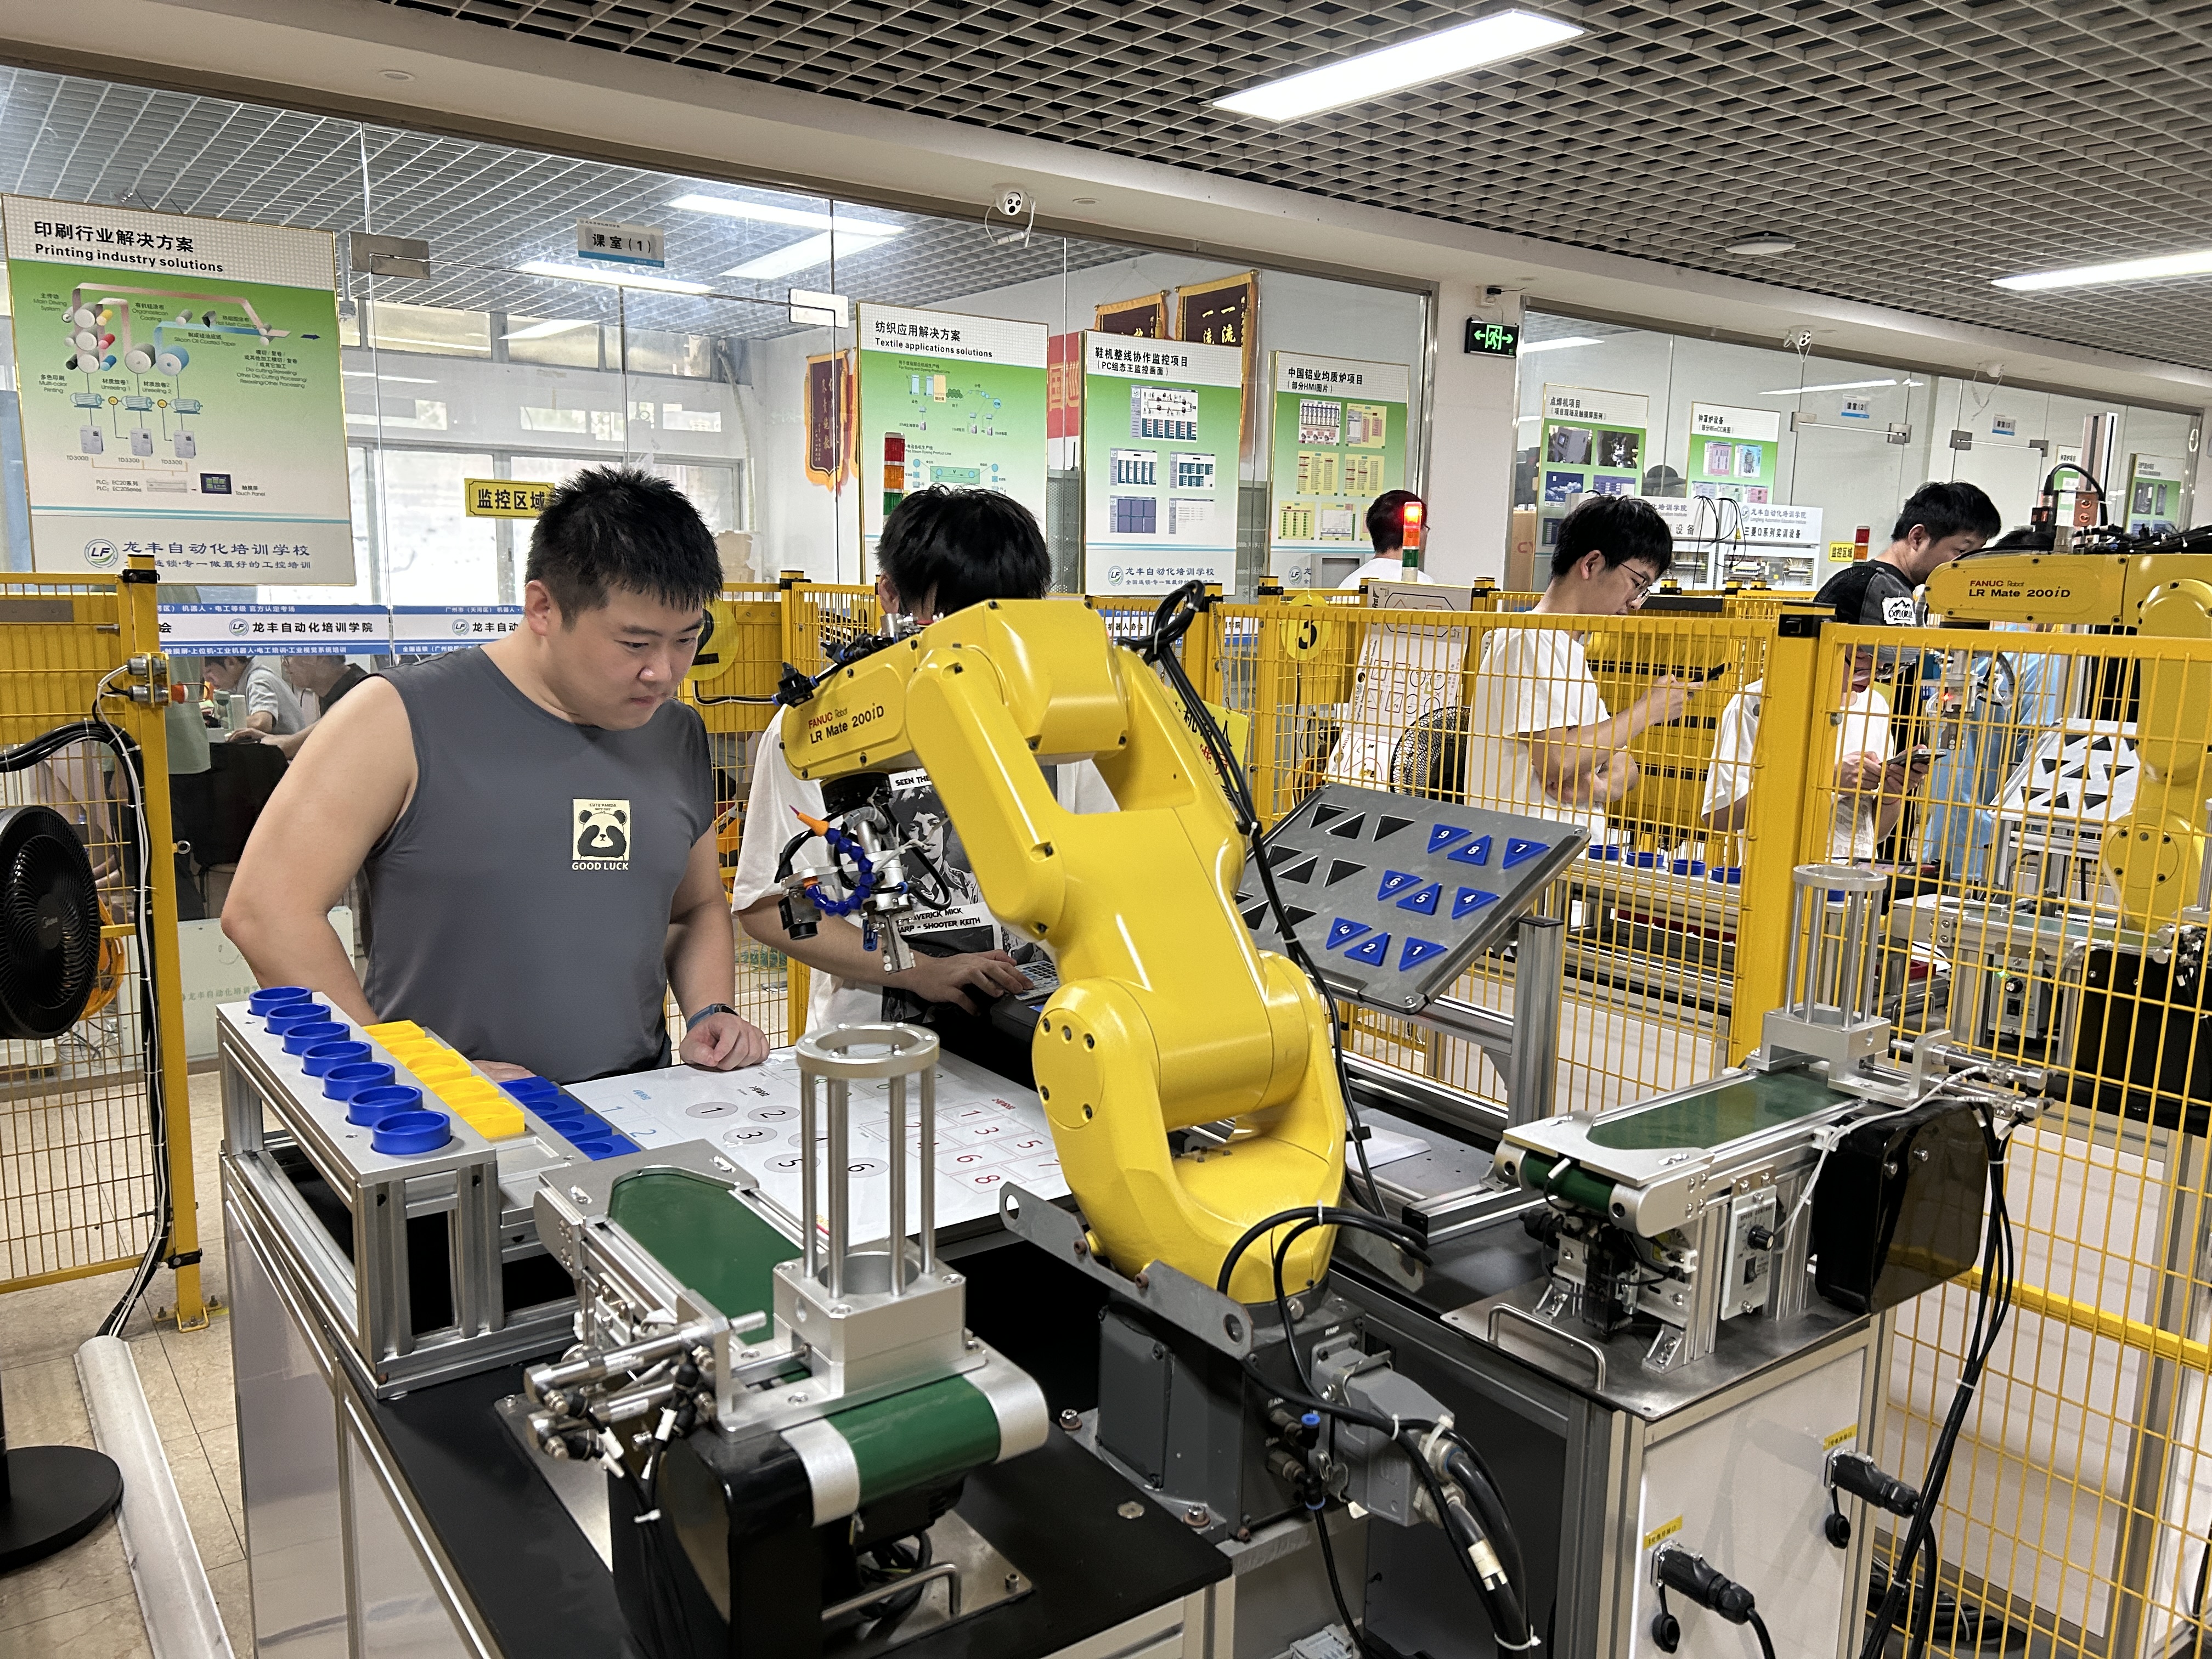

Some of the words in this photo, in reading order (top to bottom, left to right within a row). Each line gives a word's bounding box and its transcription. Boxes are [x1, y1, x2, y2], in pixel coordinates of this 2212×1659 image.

[34, 221, 194, 252] 印刷行业解决方案
[35, 243, 93, 260] Printing
[97, 250, 155, 267] industry
[160, 257, 224, 273] solutions
[875, 320, 961, 342] 纺织应用解决方案
[875, 337, 903, 349] Textile
[905, 340, 955, 355] applications
[956, 346, 992, 358] solutions
[1095, 347, 1187, 367] 鞋机整线协作监控项目
[1288, 367, 1362, 385] 中国铝业均质炉项目
[1550, 396, 1580, 408] 点焊机项目
[477, 489, 545, 510] 监控区域
[91, 548, 110, 557] LF
[122, 541, 310, 556] 龙丰自动化培训学校
[1125, 567, 1215, 575] 龙丰自动化培训学校
[2027, 586, 2070, 597] 200iD
[253, 622, 373, 633] 龙丰自动化培训学院
[808, 712, 833, 729] FANUC
[834, 707, 848, 719] Robot
[810, 730, 822, 744] LR
[826, 722, 848, 738] Mate
[852, 703, 884, 728] 200iD
[895, 777, 914, 787] SEEN
[916, 775, 931, 785] THE
[1438, 830, 1449, 839] 9
[1468, 845, 1479, 855] 8
[1516, 843, 1527, 853] 7
[1390, 877, 1401, 886] 6
[1417, 894, 1427, 904] 5
[1463, 894, 1475, 904] 4
[945, 908, 963, 916] MICK
[923, 920, 958, 930] SHOOTER
[960, 917, 981, 927] KEITH
[1340, 926, 1349, 935] 3
[1362, 943, 1373, 953] 2
[1412, 946, 1421, 956] 1
[760, 1110, 786, 1119] 2
[629, 1129, 657, 1138] 2
[737, 1131, 763, 1139] 3
[975, 1127, 999, 1135] 3
[1017, 1140, 1043, 1148] 5
[957, 1154, 983, 1163] 6
[848, 1164, 874, 1172] 6
[975, 1175, 1001, 1184] 8
